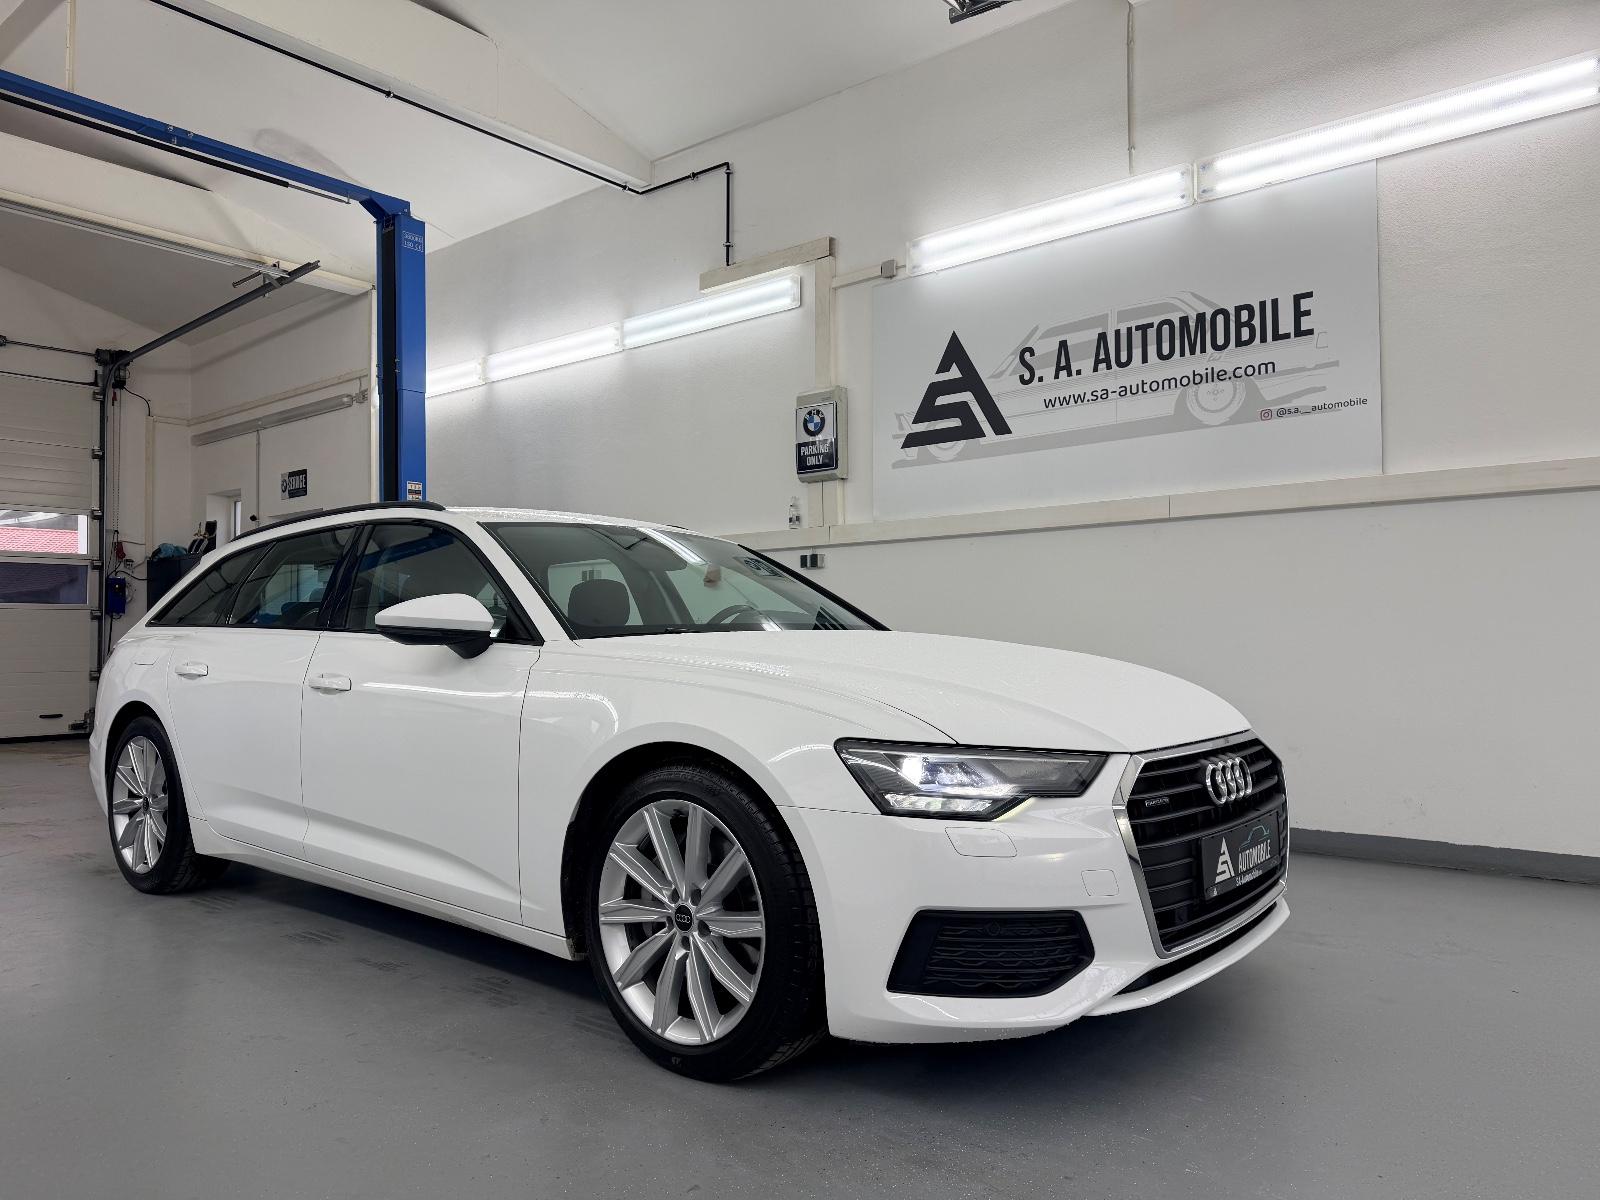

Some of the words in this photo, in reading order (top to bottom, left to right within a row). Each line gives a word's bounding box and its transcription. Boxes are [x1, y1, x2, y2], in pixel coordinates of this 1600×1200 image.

[1018, 346, 1044, 386] S.
[1053, 339, 1082, 380] A.
[1092, 290, 1315, 373] AUTOMOBILE
[1043, 360, 1277, 409] www.sa-automobile.com
[800, 443, 829, 457] PARKING
[806, 454, 823, 466] ONLY
[1238, 839, 1271, 874] AUTOMOBILE
